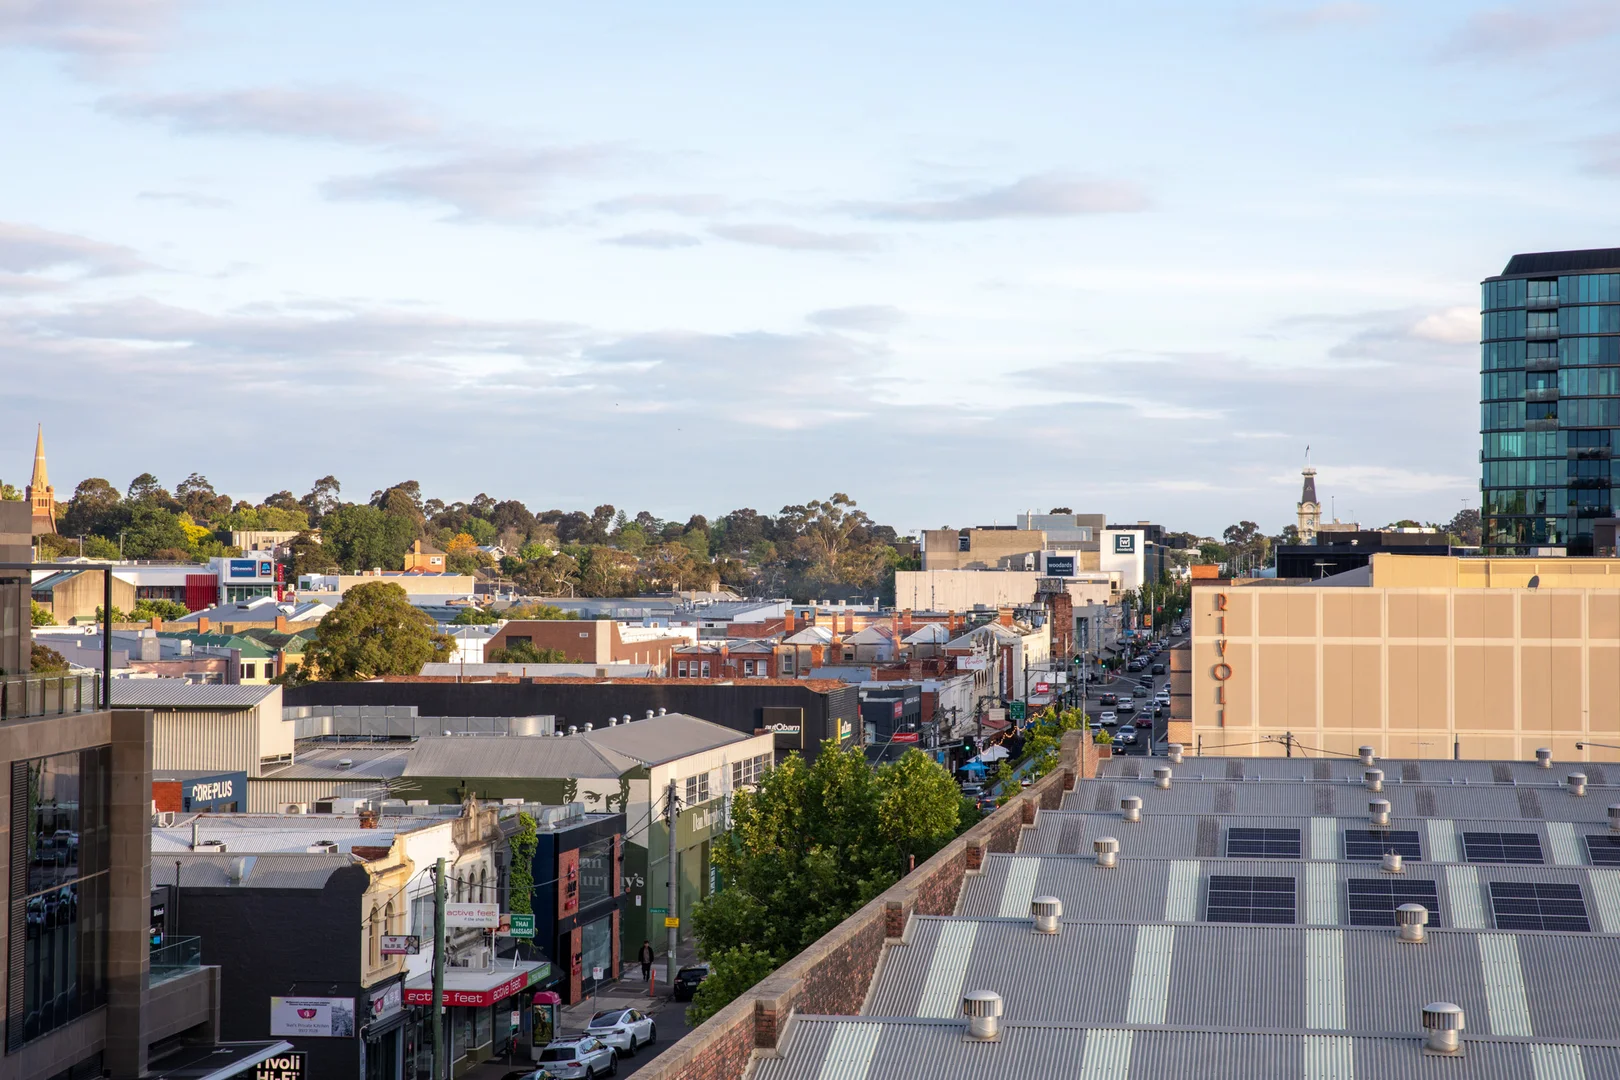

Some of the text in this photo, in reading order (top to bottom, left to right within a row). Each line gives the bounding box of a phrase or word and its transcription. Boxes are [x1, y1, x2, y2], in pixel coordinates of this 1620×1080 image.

[1213, 593, 1233, 728] RIVOLI
[692, 812, 704, 832] Dan
[446, 909, 496, 917] active feet
[408, 992, 449, 1001] actie
[454, 993, 483, 1003] feet
[493, 978, 521, 1000] active feet
